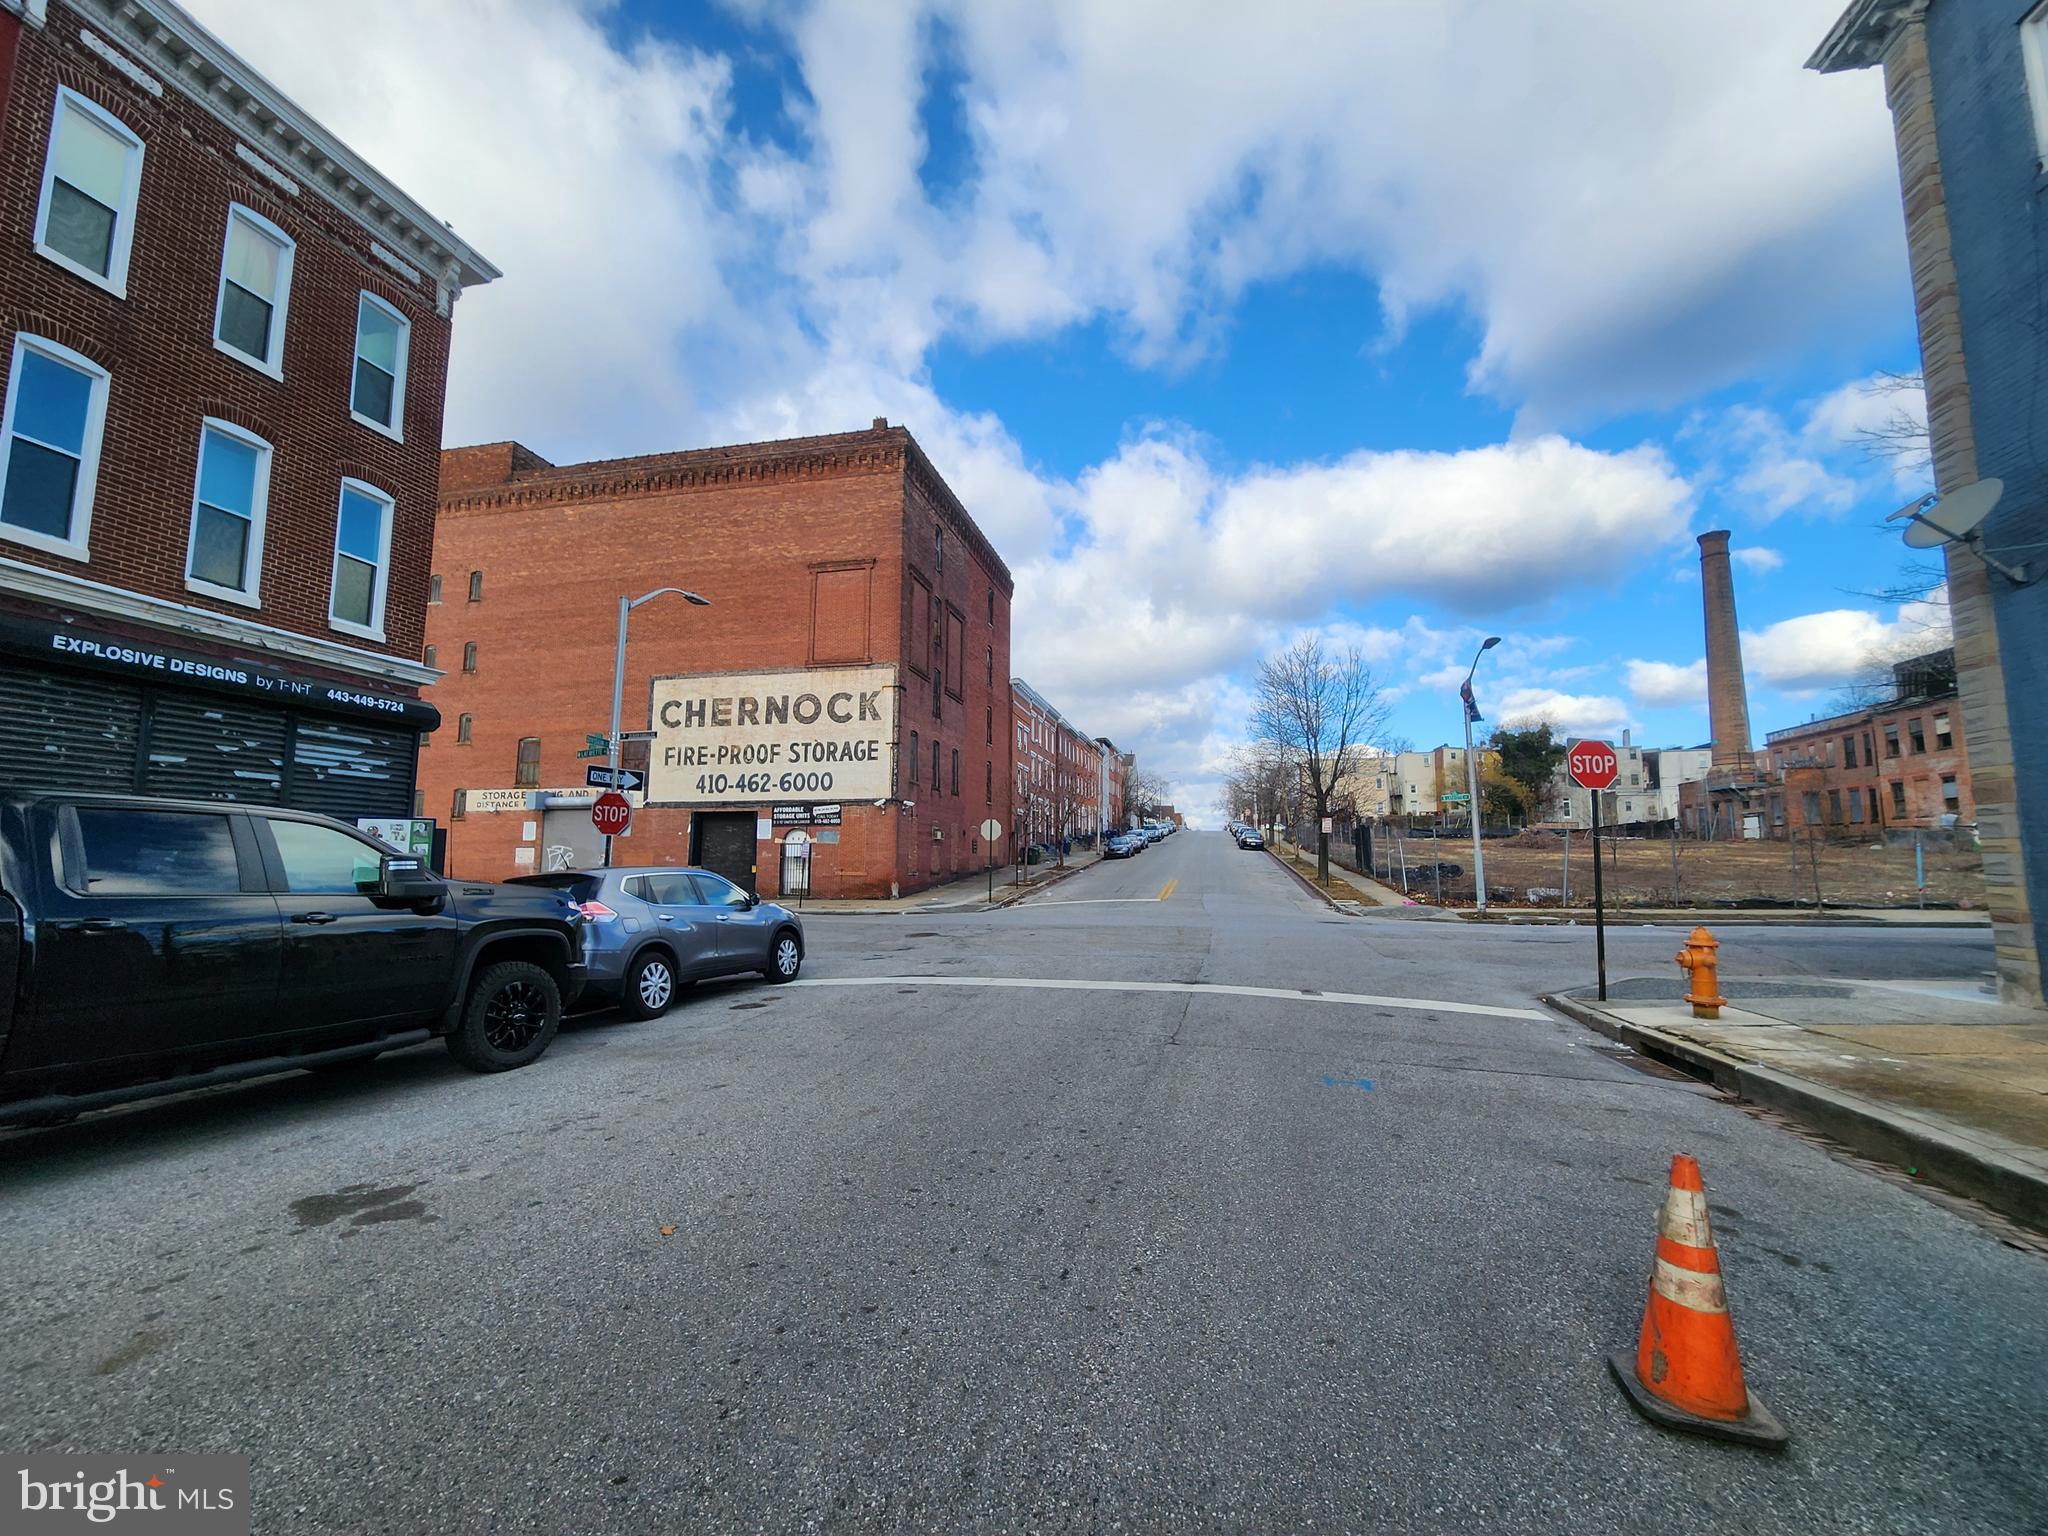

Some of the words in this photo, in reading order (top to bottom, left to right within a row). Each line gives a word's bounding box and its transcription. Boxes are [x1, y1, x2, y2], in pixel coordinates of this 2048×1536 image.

[52, 634, 165, 669] EXPLOSIVE
[170, 658, 248, 684] DESIGNS
[256, 674, 273, 690] by
[327, 689, 404, 713] 443-449-5724
[660, 690, 881, 729] CHERNOCK
[664, 743, 781, 766] FIRE-PROOF
[787, 739, 879, 764] STORAGE
[1573, 755, 1614, 773] STOP
[592, 772, 607, 781] ONE
[696, 771, 834, 794] 410-462-6000
[476, 800, 519, 808] DISTANCE
[482, 791, 527, 800] STORAGE
[594, 805, 628, 822] STOP
